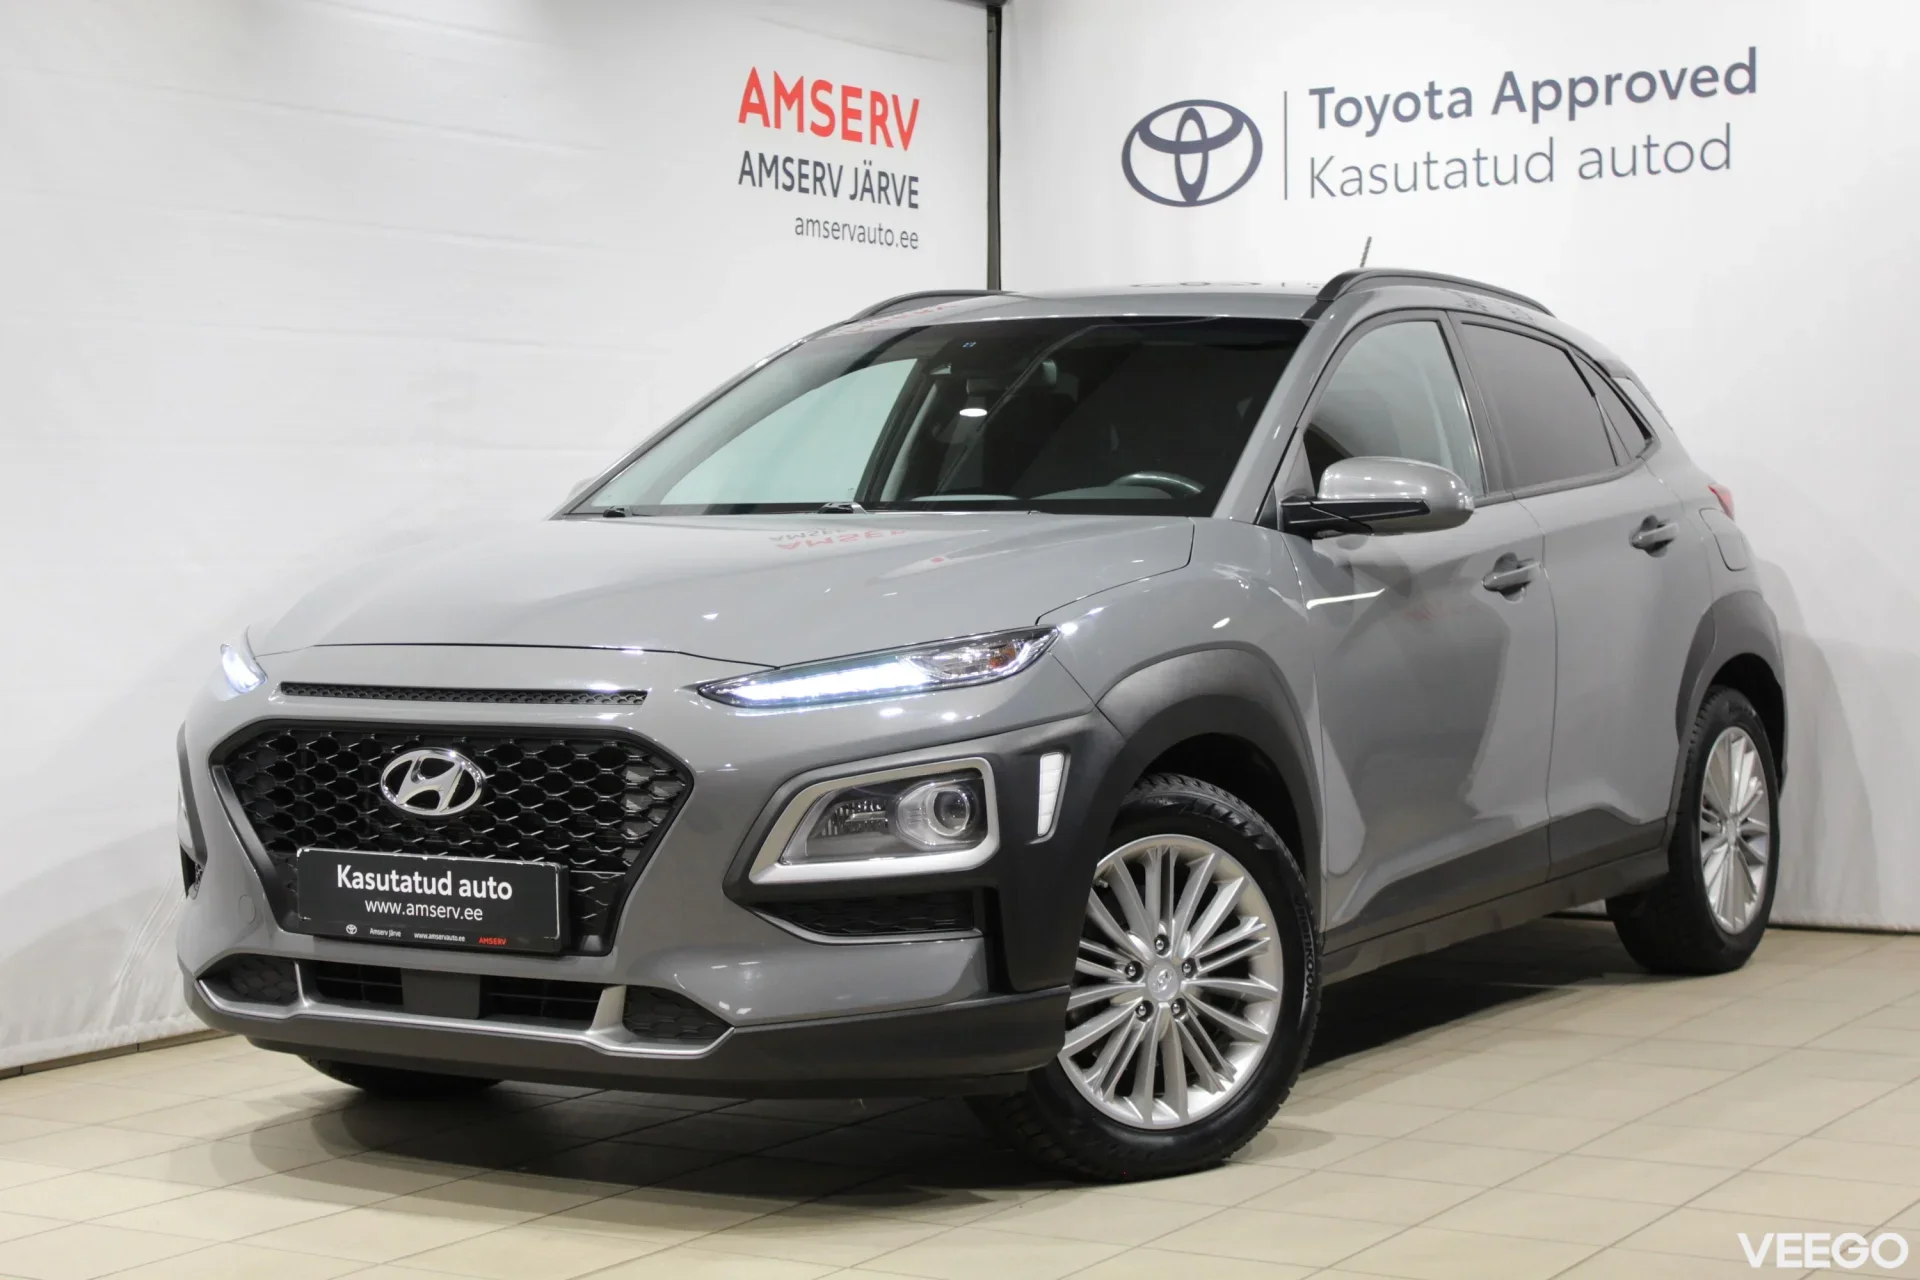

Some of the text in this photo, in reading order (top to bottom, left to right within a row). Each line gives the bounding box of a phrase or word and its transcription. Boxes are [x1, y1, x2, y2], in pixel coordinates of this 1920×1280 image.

[738, 66, 921, 151] AMSERV
[1308, 46, 1757, 138] Toyota Approved
[1310, 122, 1731, 199] Kasutatud autod
[738, 150, 919, 210] AMSERV JÄRVE
[794, 216, 919, 250] amservauto.ee
[337, 864, 513, 900] Kasutatud auto
[364, 899, 483, 921] www.amserv.ee
[369, 927, 388, 937] Amserv
[414, 932, 466, 943] www.amservauto.ee
[478, 936, 507, 946] AMSERV
